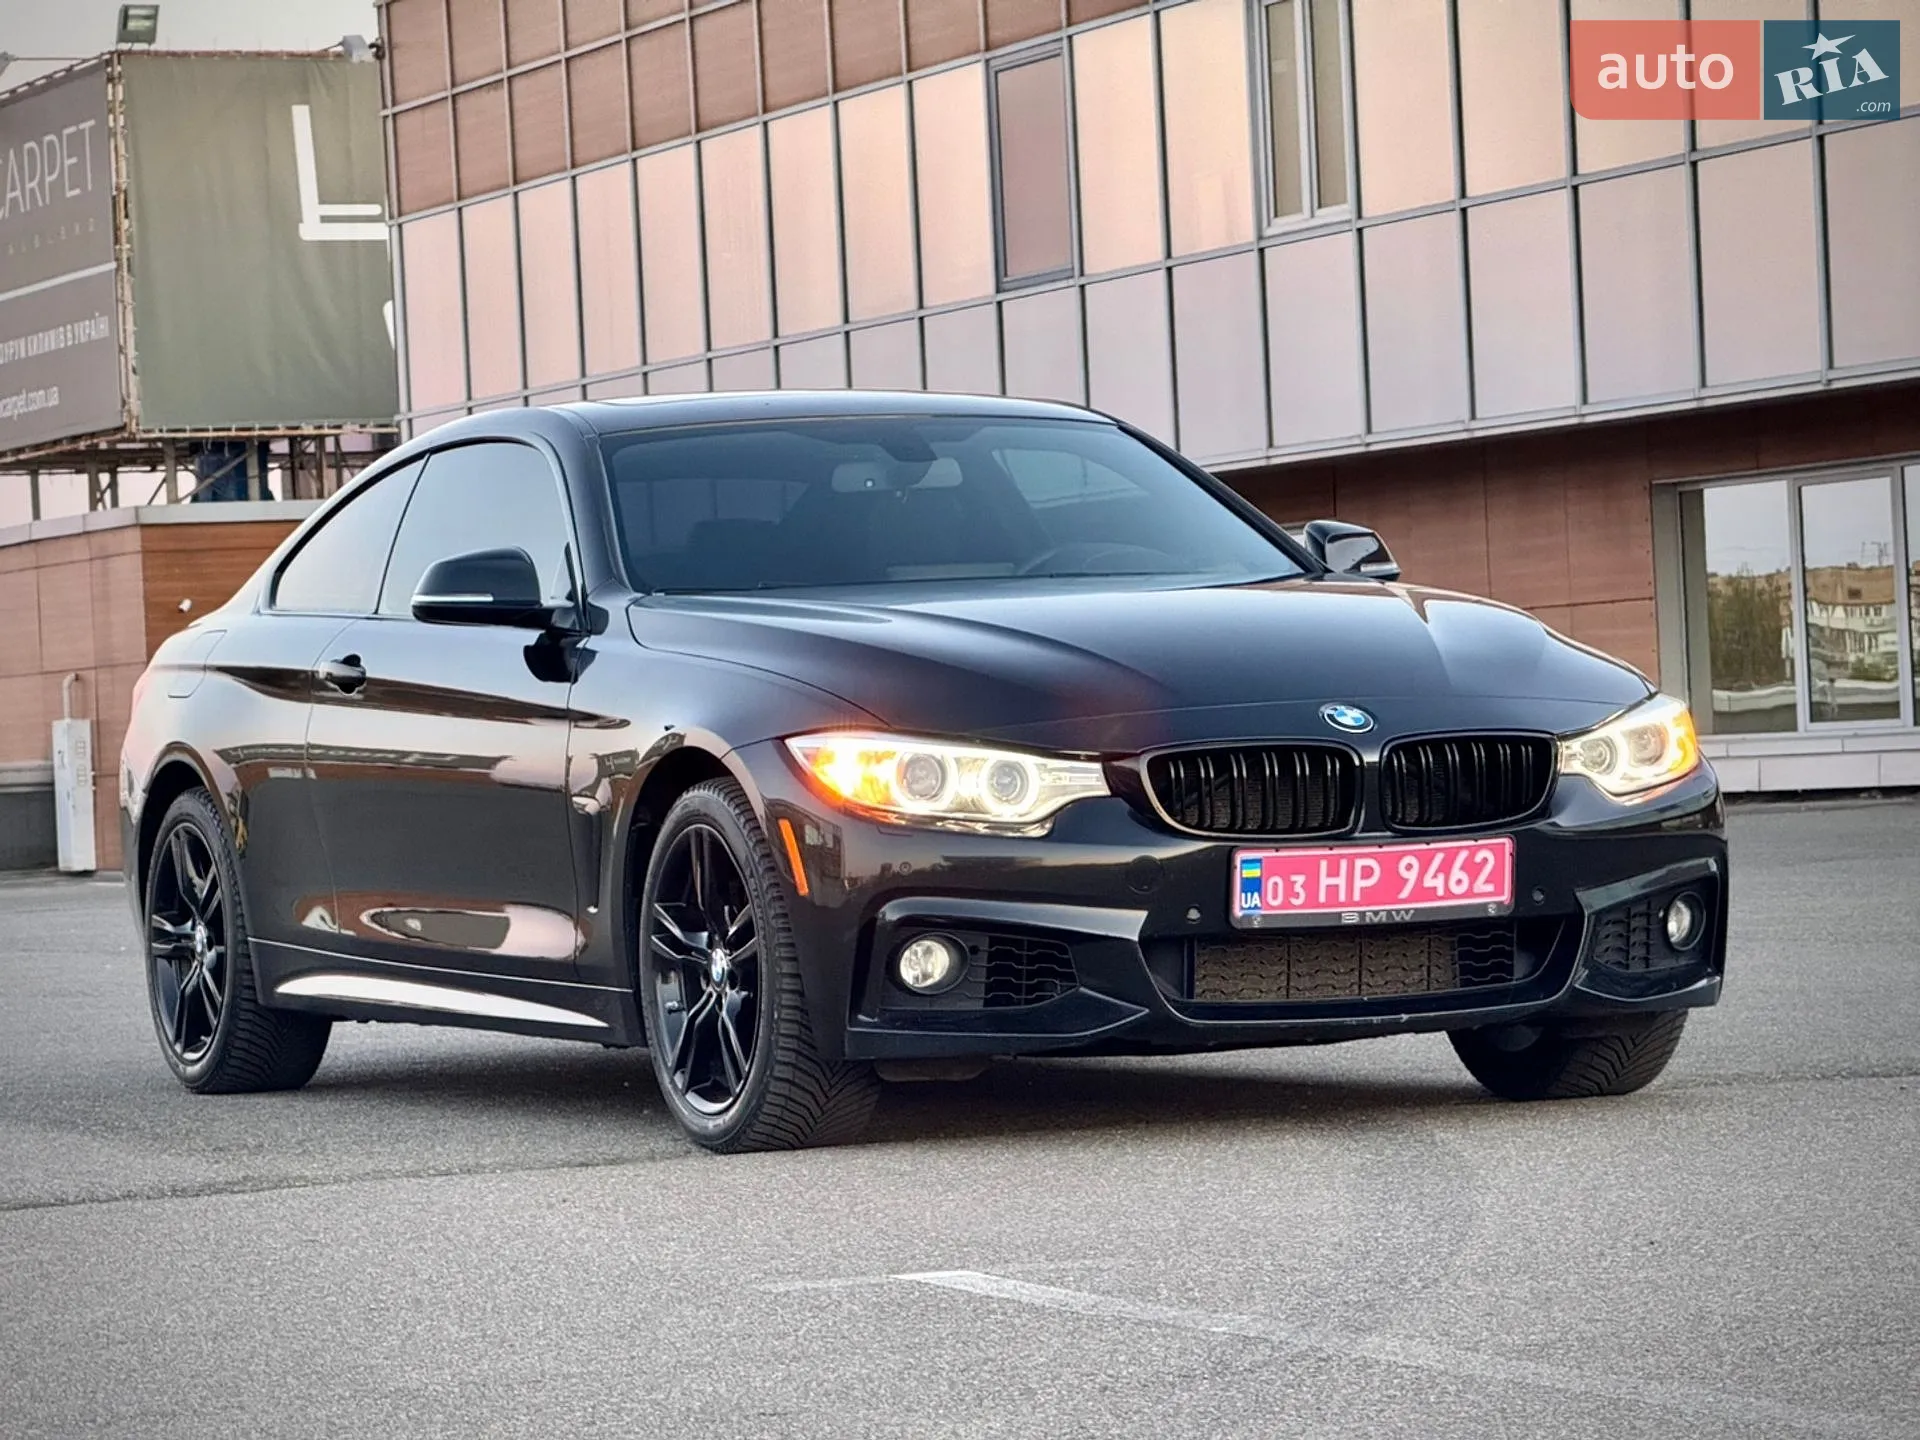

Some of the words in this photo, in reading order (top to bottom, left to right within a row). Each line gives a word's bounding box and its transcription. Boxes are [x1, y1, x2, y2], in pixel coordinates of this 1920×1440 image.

[0, 119, 96, 220] ARPET
[1266, 874, 1306, 906] 03
[1318, 858, 1381, 903] HP
[1397, 849, 1496, 900] 9462
[1242, 892, 1261, 908] UA
[1340, 910, 1414, 924] BMW
